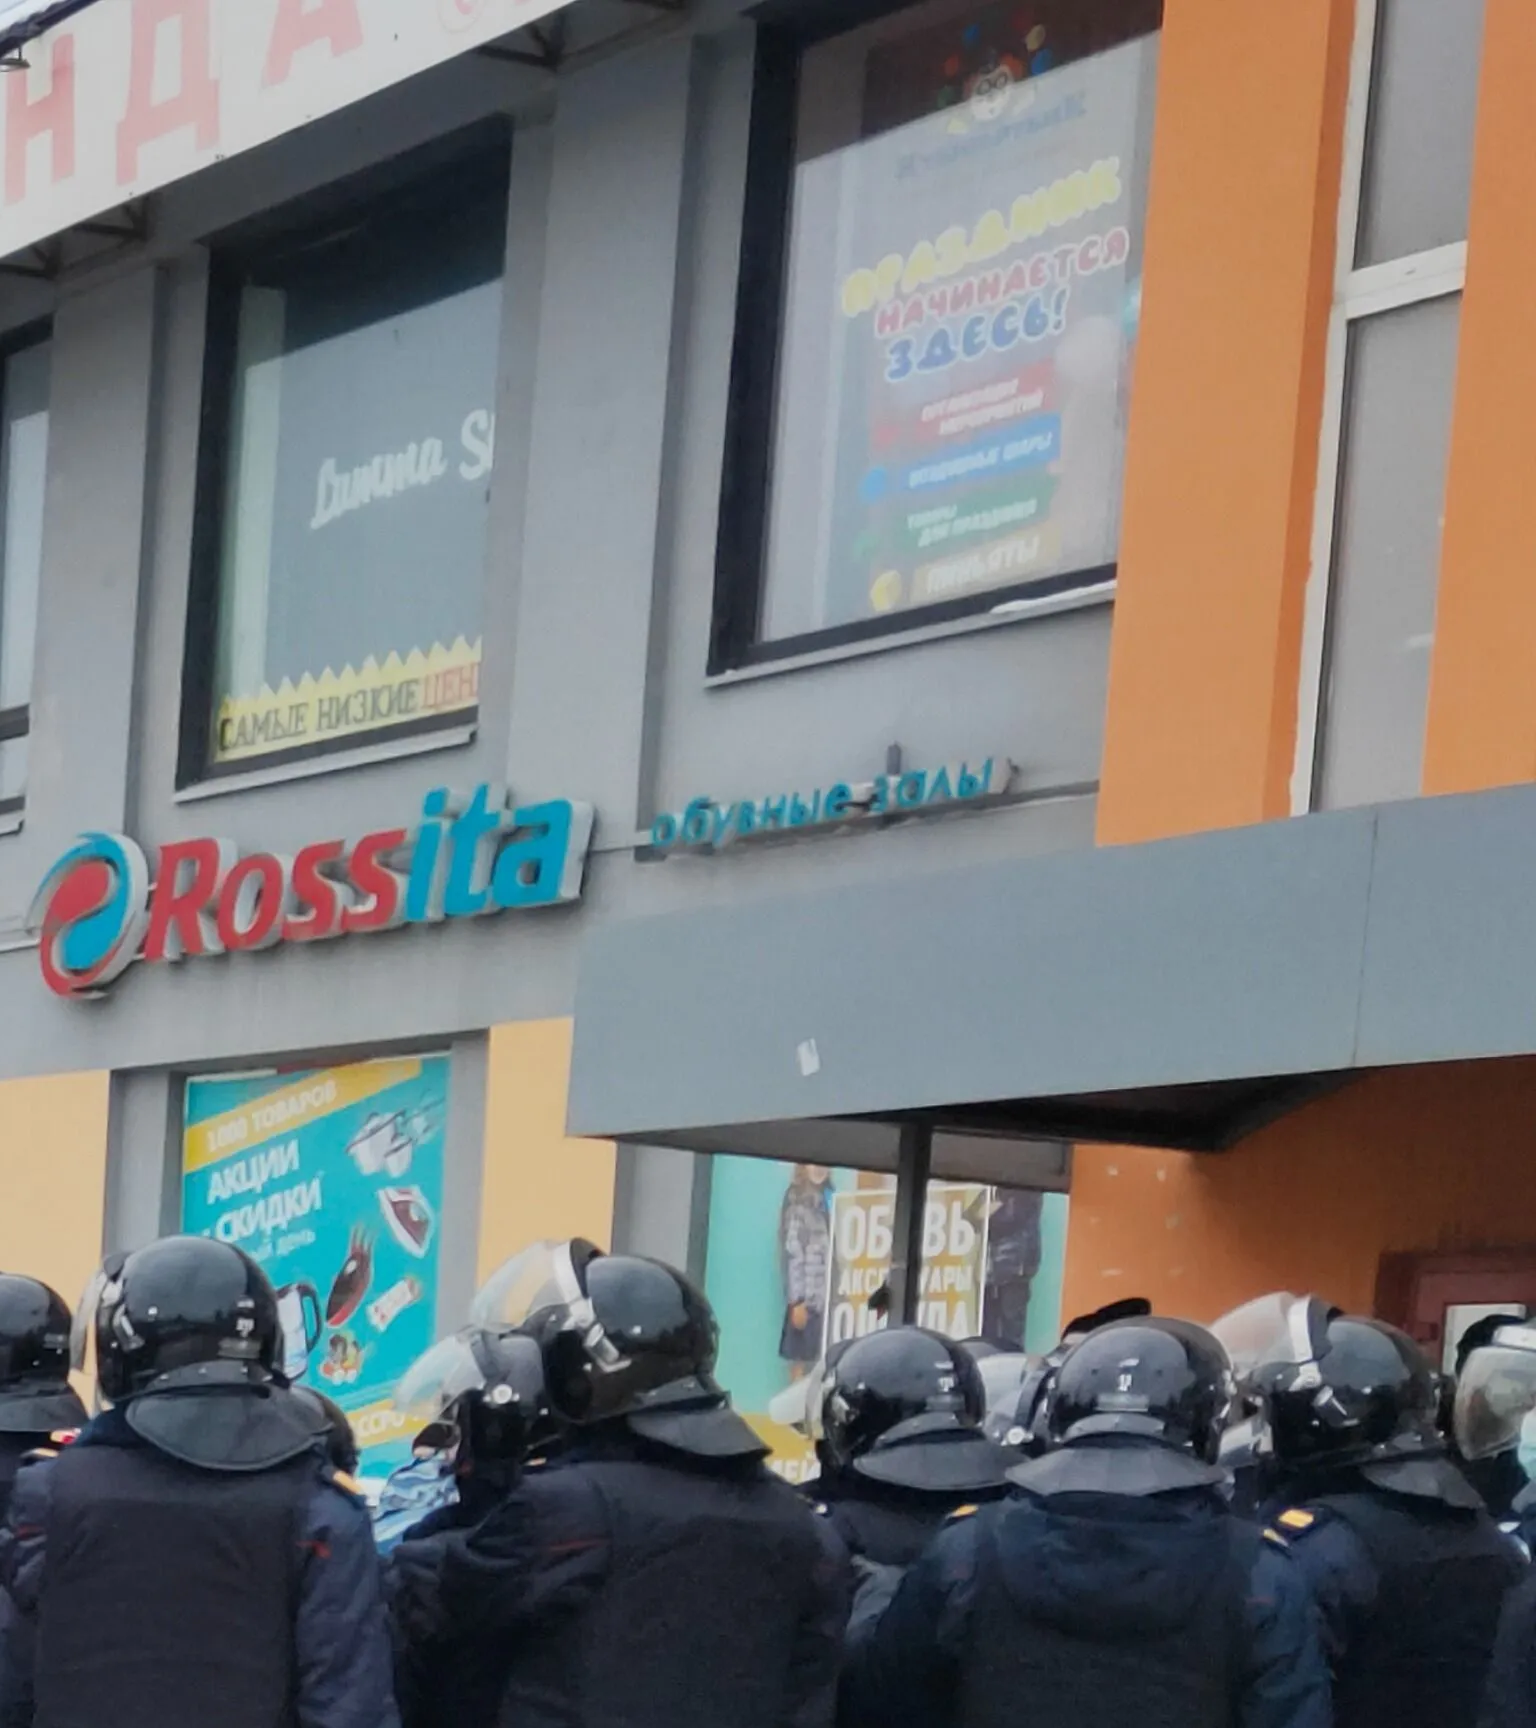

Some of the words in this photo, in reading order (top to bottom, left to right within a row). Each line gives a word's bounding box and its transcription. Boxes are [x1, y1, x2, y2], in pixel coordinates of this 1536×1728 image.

[874, 226, 1129, 340] НАЧИНАЕТСЯ
[885, 286, 1070, 383] ЗДЕСЬ!
[219, 702, 309, 751] САМЫЕ
[316, 678, 420, 733] НИЗКИЕ
[650, 779, 854, 848] обувные
[872, 756, 995, 814] залы
[143, 780, 588, 962] Rossita
[251, 1080, 337, 1131] ТОВАРОВ
[207, 1138, 300, 1205] АКЦИИ
[216, 1177, 323, 1244] СКИДКИ
[841, 1201, 975, 1261] ОБВЬ
